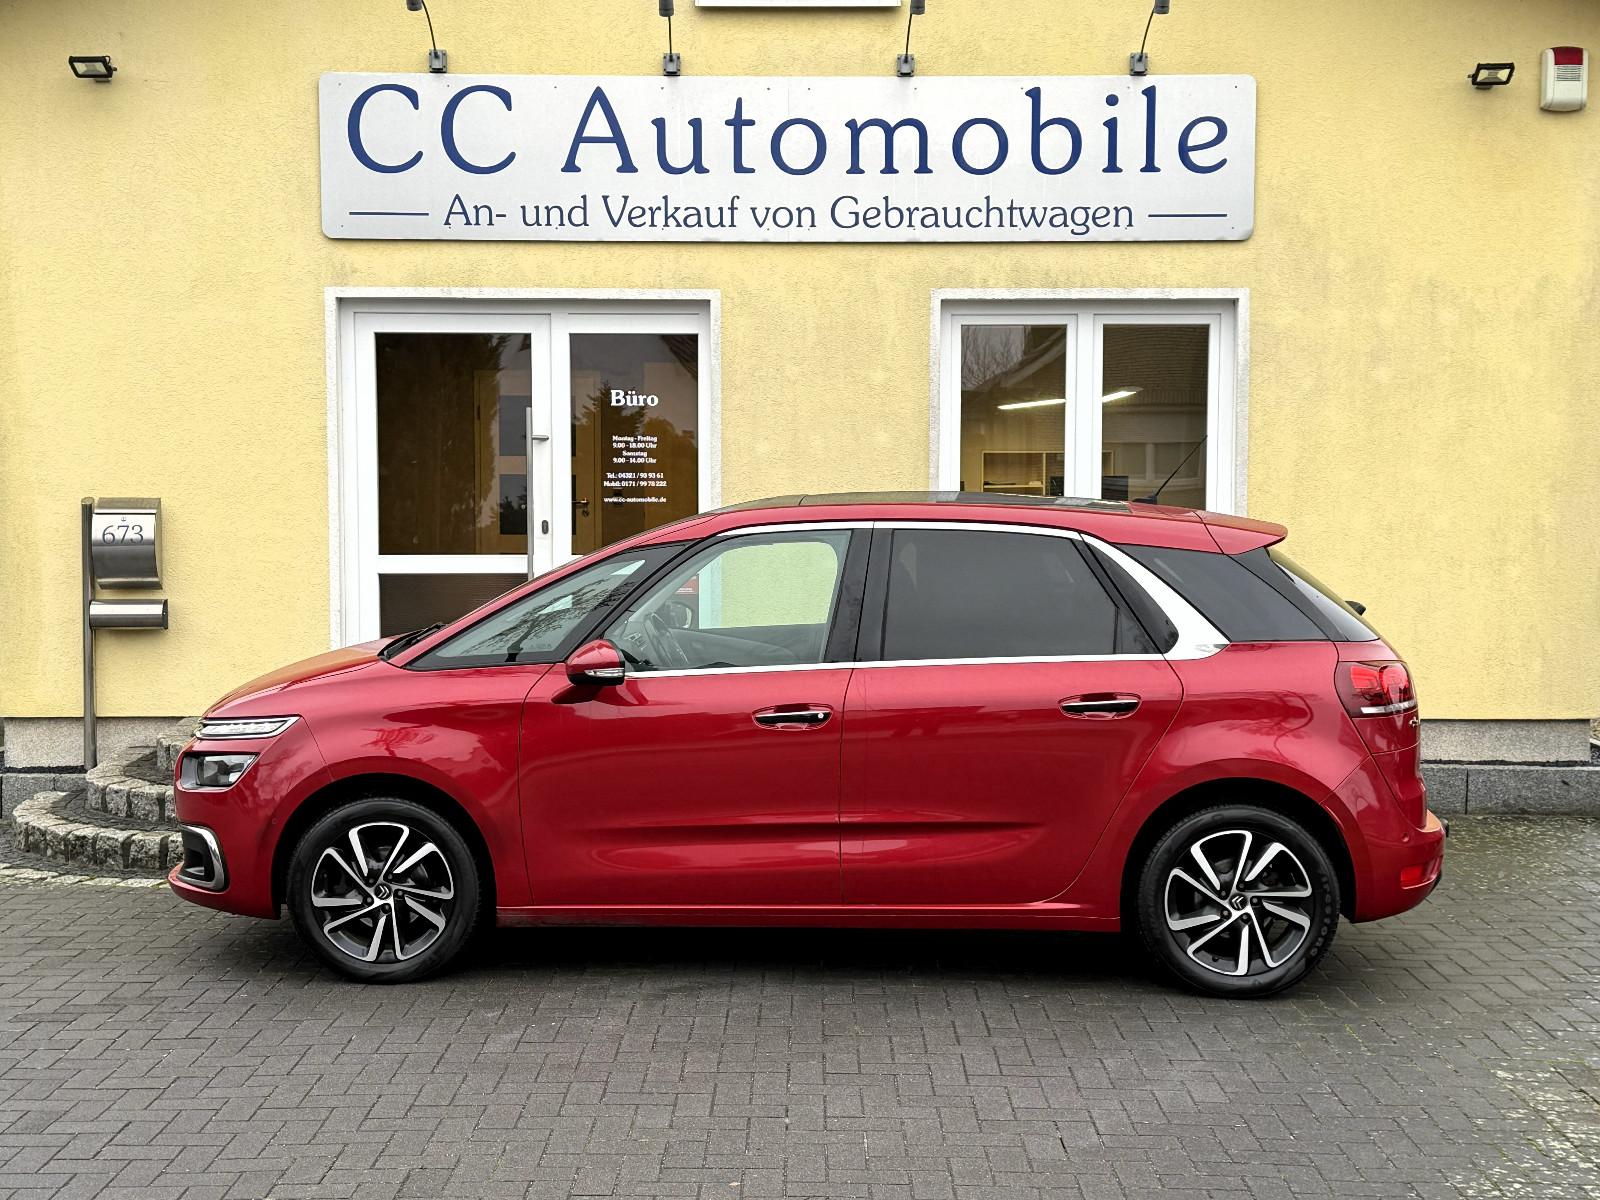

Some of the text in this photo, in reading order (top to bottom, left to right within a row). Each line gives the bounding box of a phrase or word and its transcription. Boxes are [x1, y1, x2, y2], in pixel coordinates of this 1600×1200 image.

[347, 83, 1228, 175] CC Automobile
[443, 193, 1134, 236] An- und Verkauf von Gebrauchtwagen
[610, 389, 659, 407] Büro
[102, 524, 144, 545] 673
